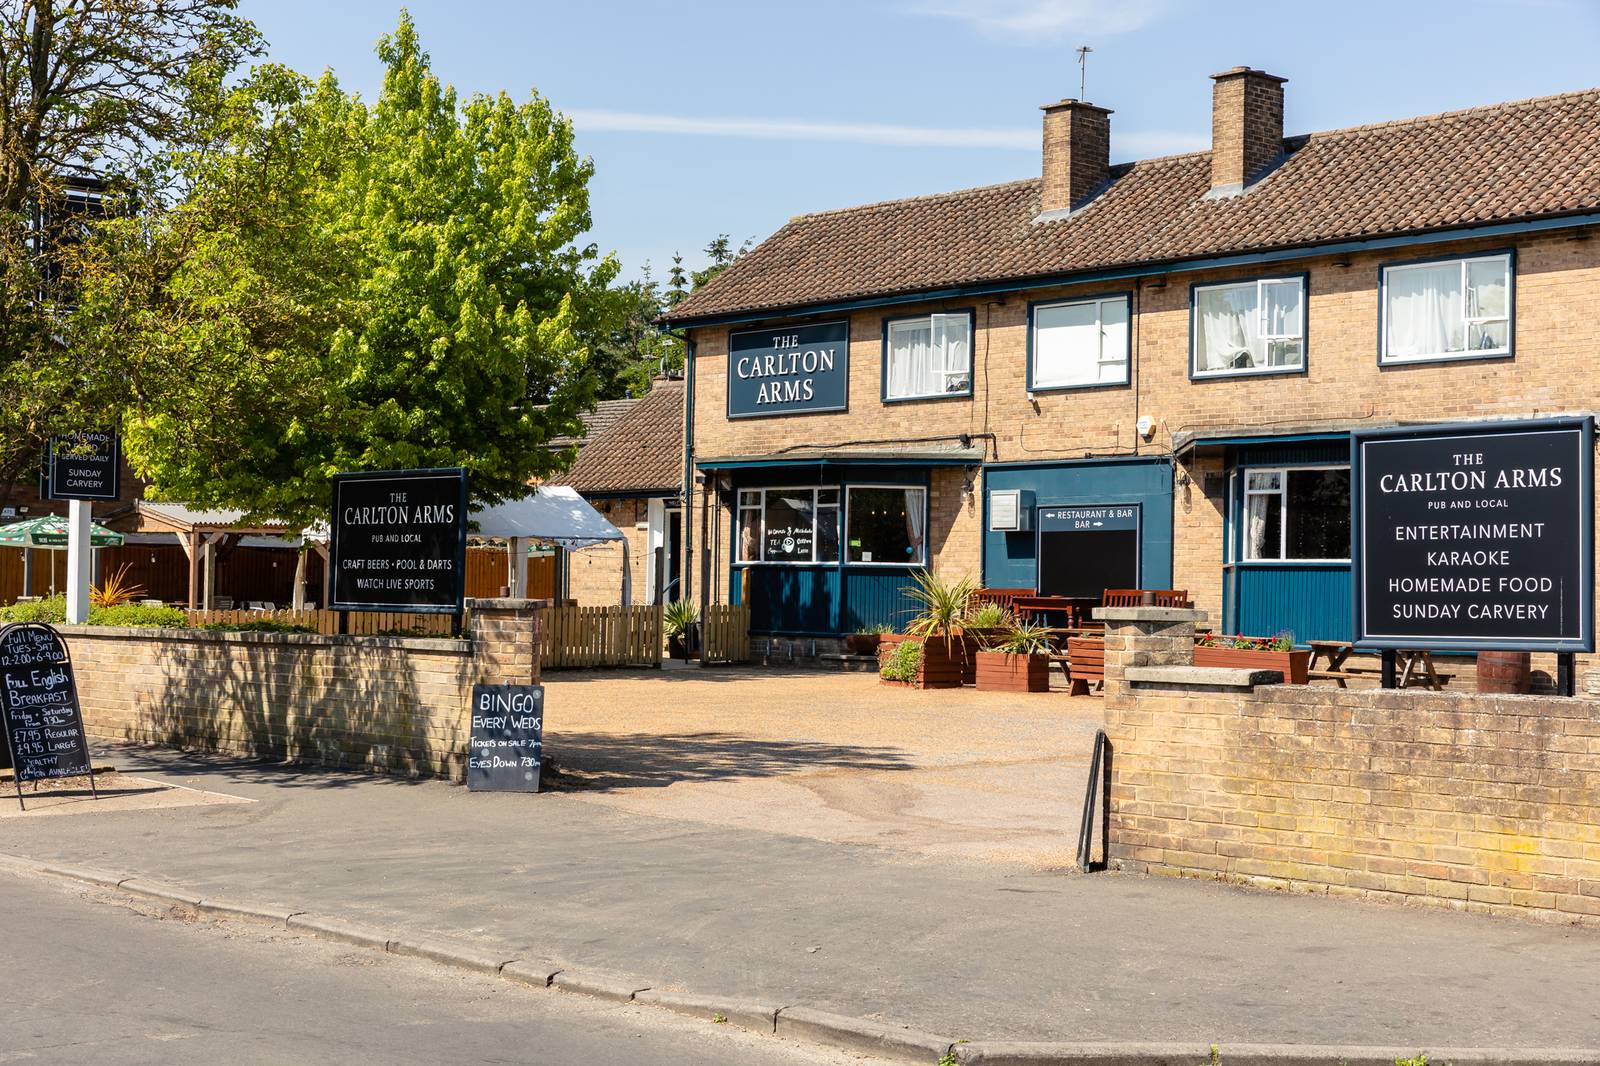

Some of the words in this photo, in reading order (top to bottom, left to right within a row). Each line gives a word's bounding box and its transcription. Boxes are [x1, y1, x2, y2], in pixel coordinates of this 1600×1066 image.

[773, 335, 799, 349] THE
[738, 350, 834, 378] CARLTON
[756, 379, 814, 404] ARMS
[73, 443, 98, 452] FD
[1453, 453, 1484, 466] THE
[68, 468, 102, 477] SUNDAY
[66, 480, 103, 488] CARVERY
[1380, 470, 1486, 492] CARLTON
[1494, 468, 1562, 488] ARMS
[390, 492, 407, 502] THE
[1428, 501, 1446, 510] PUB
[1450, 500, 1472, 509] AND
[1476, 499, 1508, 508] LOCAL
[344, 506, 408, 525] CARLTON
[413, 504, 454, 524] ARMS
[1057, 510, 1106, 520] RESTAURANT
[1075, 520, 1090, 528] BAR
[372, 534, 384, 542] PUB
[386, 534, 399, 542] AND
[401, 534, 422, 542] LOCAL
[1396, 523, 1544, 540] ENTERTAINMENT
[342, 560, 365, 569] CRAFT
[367, 560, 390, 569] BEERS
[396, 560, 417, 569] POOL
[420, 560, 425, 569] &
[427, 560, 452, 570] DARTS
[1427, 551, 1510, 566] KARAOKE
[357, 578, 383, 589] WATCH
[386, 578, 402, 589] LIVE
[404, 579, 435, 590] SPORTS
[1389, 578, 1491, 592] HOMEMADE
[1499, 578, 1552, 592] FOOD
[1392, 604, 1461, 619] SUNDAY
[1468, 604, 1549, 619] CARVERY
[31, 668, 69, 690] English
[480, 693, 534, 713] BINGO
[41, 707, 73, 716] Saturday
[472, 715, 507, 729] EVERY
[511, 715, 541, 730] WEDS
[15, 730, 41, 742] £7.95
[44, 728, 79, 739] REGULAR
[17, 742, 44, 755] £9.95
[48, 740, 76, 751] LARGE
[470, 736, 496, 748] TICKETS
[470, 757, 492, 768] EYES
[493, 755, 517, 768] DOWN
